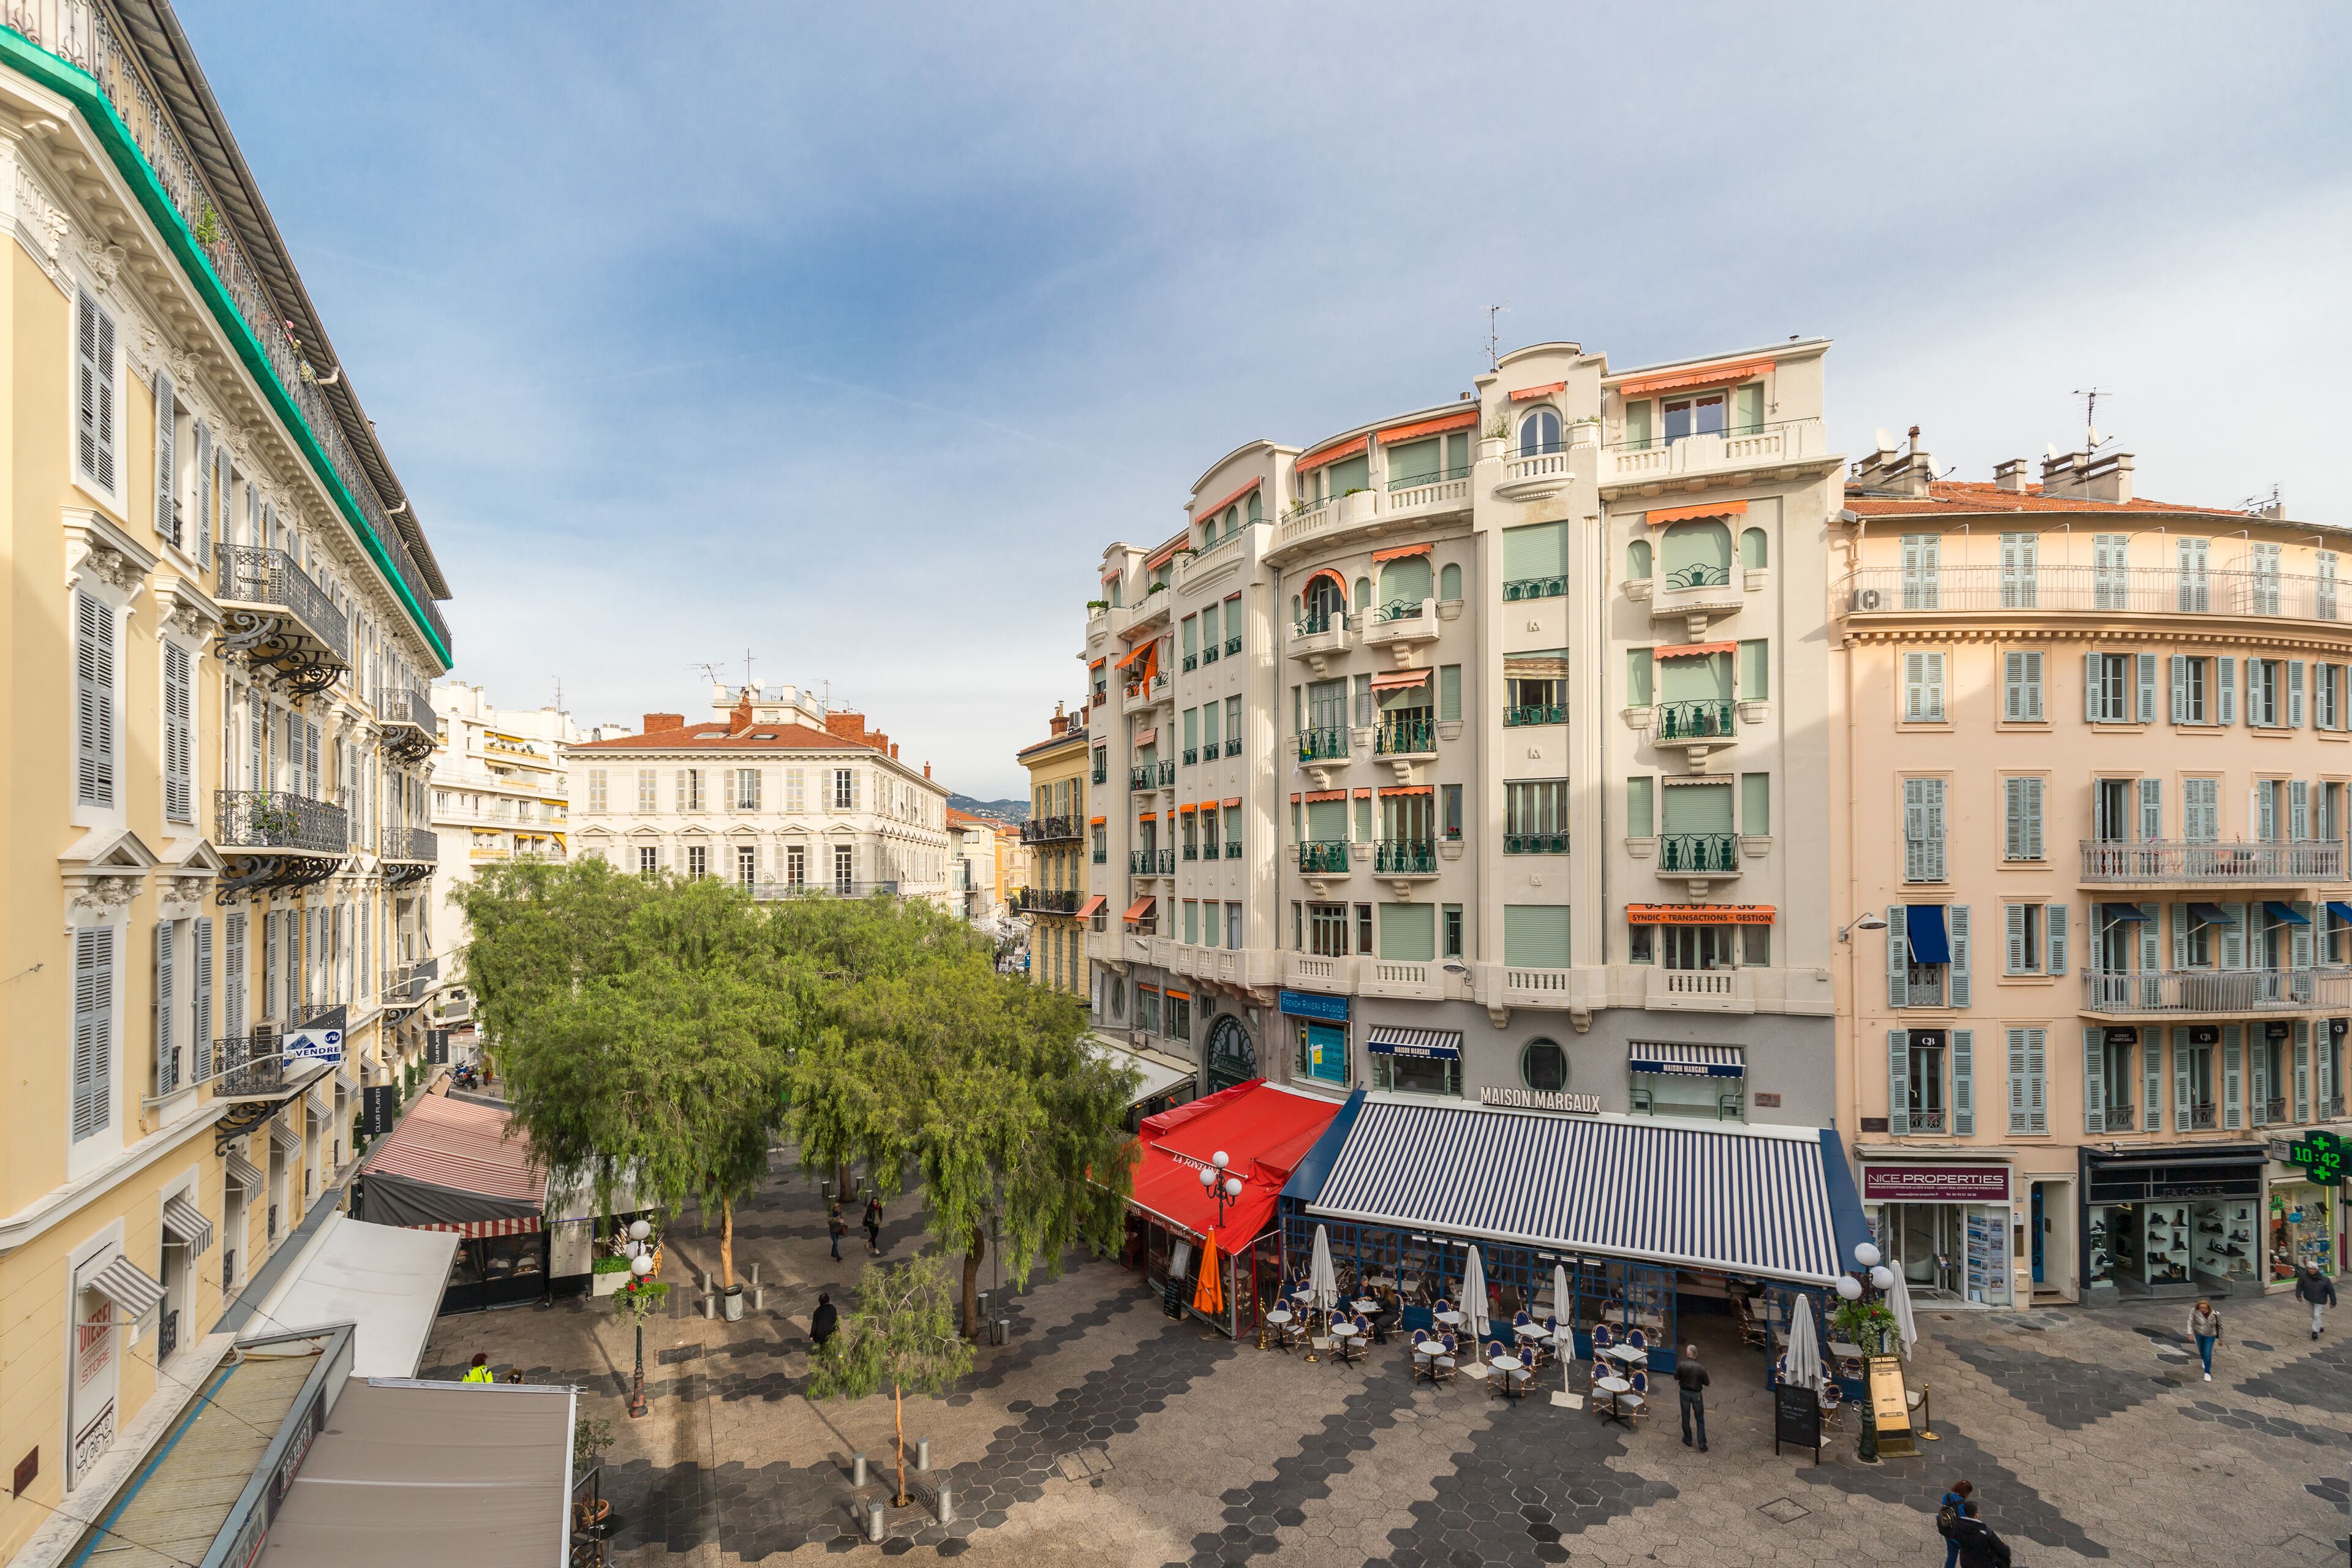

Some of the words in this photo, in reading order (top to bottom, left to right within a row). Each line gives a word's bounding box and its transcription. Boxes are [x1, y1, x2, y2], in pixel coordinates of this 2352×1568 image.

[291, 1037, 306, 1049] SAG
[296, 1046, 340, 1057] VENDRE
[1684, 1065, 1708, 1074] MARGAUX
[1480, 1086, 1531, 1107] MAISON
[1535, 1090, 1600, 1113] MARGAUX
[1172, 1154, 1183, 1164] LA
[2294, 1147, 2340, 1169] 10:42
[1868, 1174, 1901, 1183] NICE
[1903, 1175, 2004, 1184] PROPERTIES
[1122, 1200, 1142, 1216] NTAINE
[1151, 1215, 1166, 1228] Lunch
[1170, 1224, 1191, 1242] Breakfast
[80, 1300, 112, 1354] DIESEL
[81, 1335, 110, 1366] CONCEPT
[81, 1348, 110, 1383] STORE
